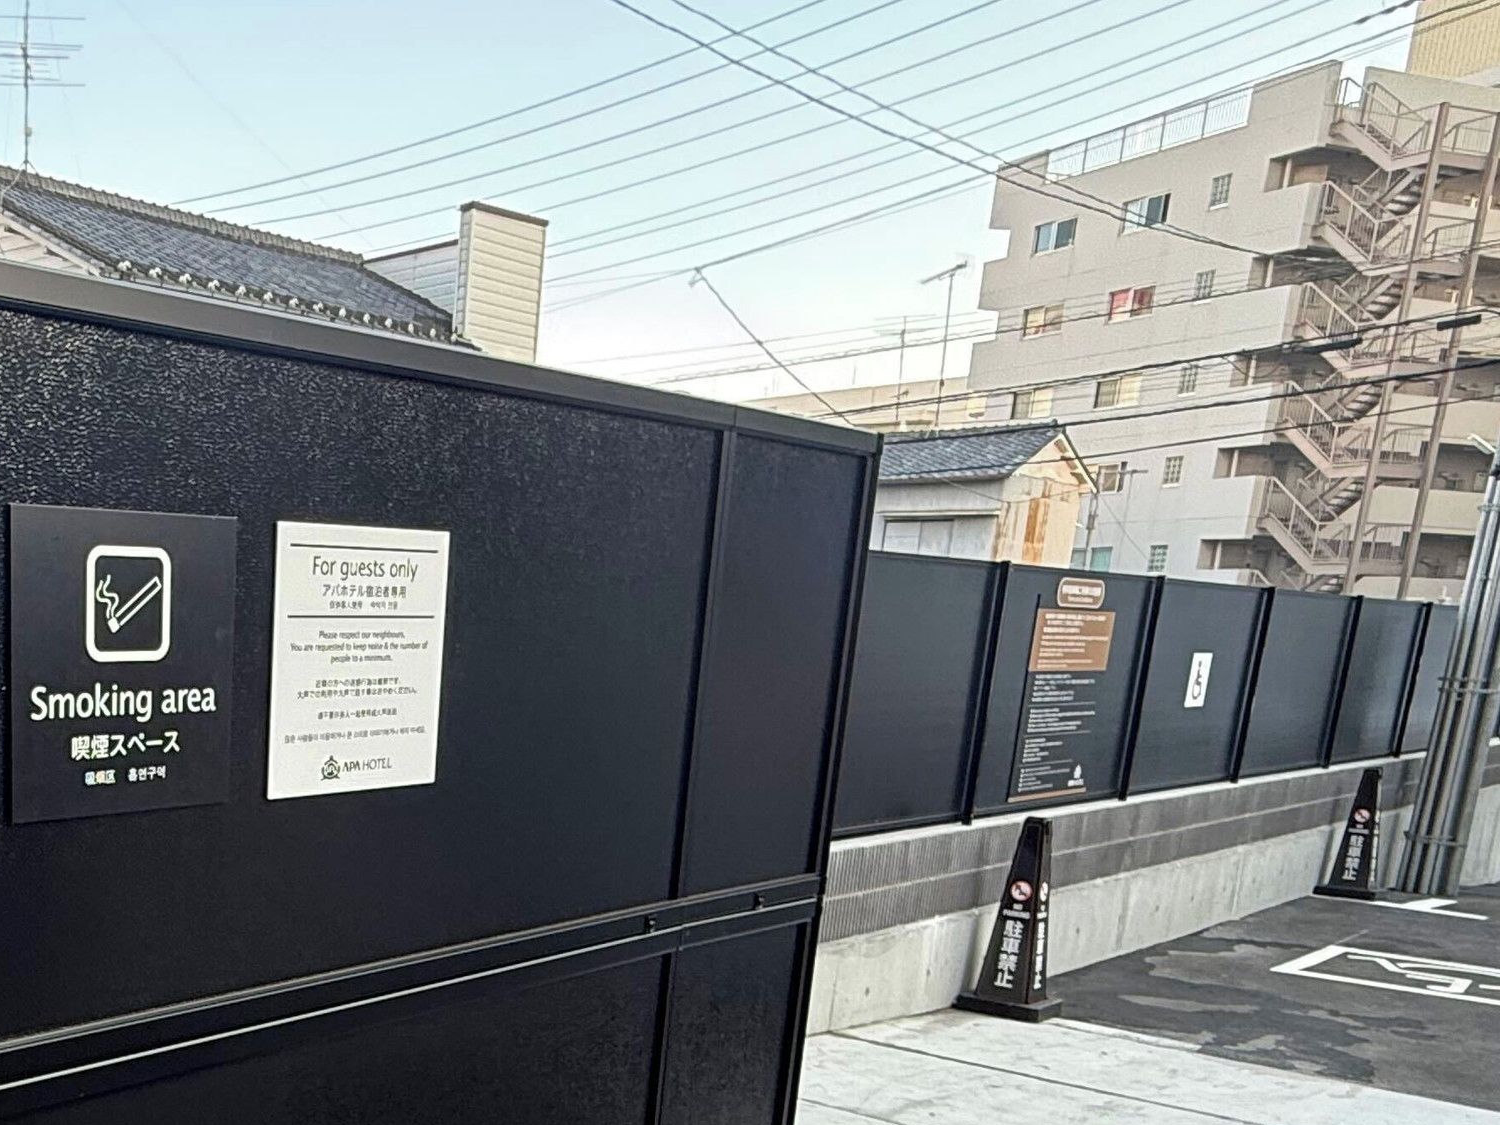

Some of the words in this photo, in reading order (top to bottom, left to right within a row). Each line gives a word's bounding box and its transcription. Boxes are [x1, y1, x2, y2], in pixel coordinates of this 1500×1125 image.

[312, 556, 337, 576] For
[340, 560, 385, 581] guests
[389, 558, 418, 583] only
[318, 630, 338, 639] Please
[339, 631, 360, 640] respect
[290, 643, 302, 651] You
[315, 642, 345, 653] requested
[346, 643, 352, 651] to
[353, 642, 367, 652] keep
[389, 641, 398, 650] the
[400, 641, 420, 650] number
[421, 640, 428, 649] of
[331, 654, 350, 664] people
[30, 682, 152, 723] Smoking
[161, 687, 216, 714] area
[70, 731, 181, 761] 喫煙スペース
[342, 760, 360, 772] APA
[363, 757, 392, 771] HOTEL
[994, 920, 1024, 989] 駐車禁止
